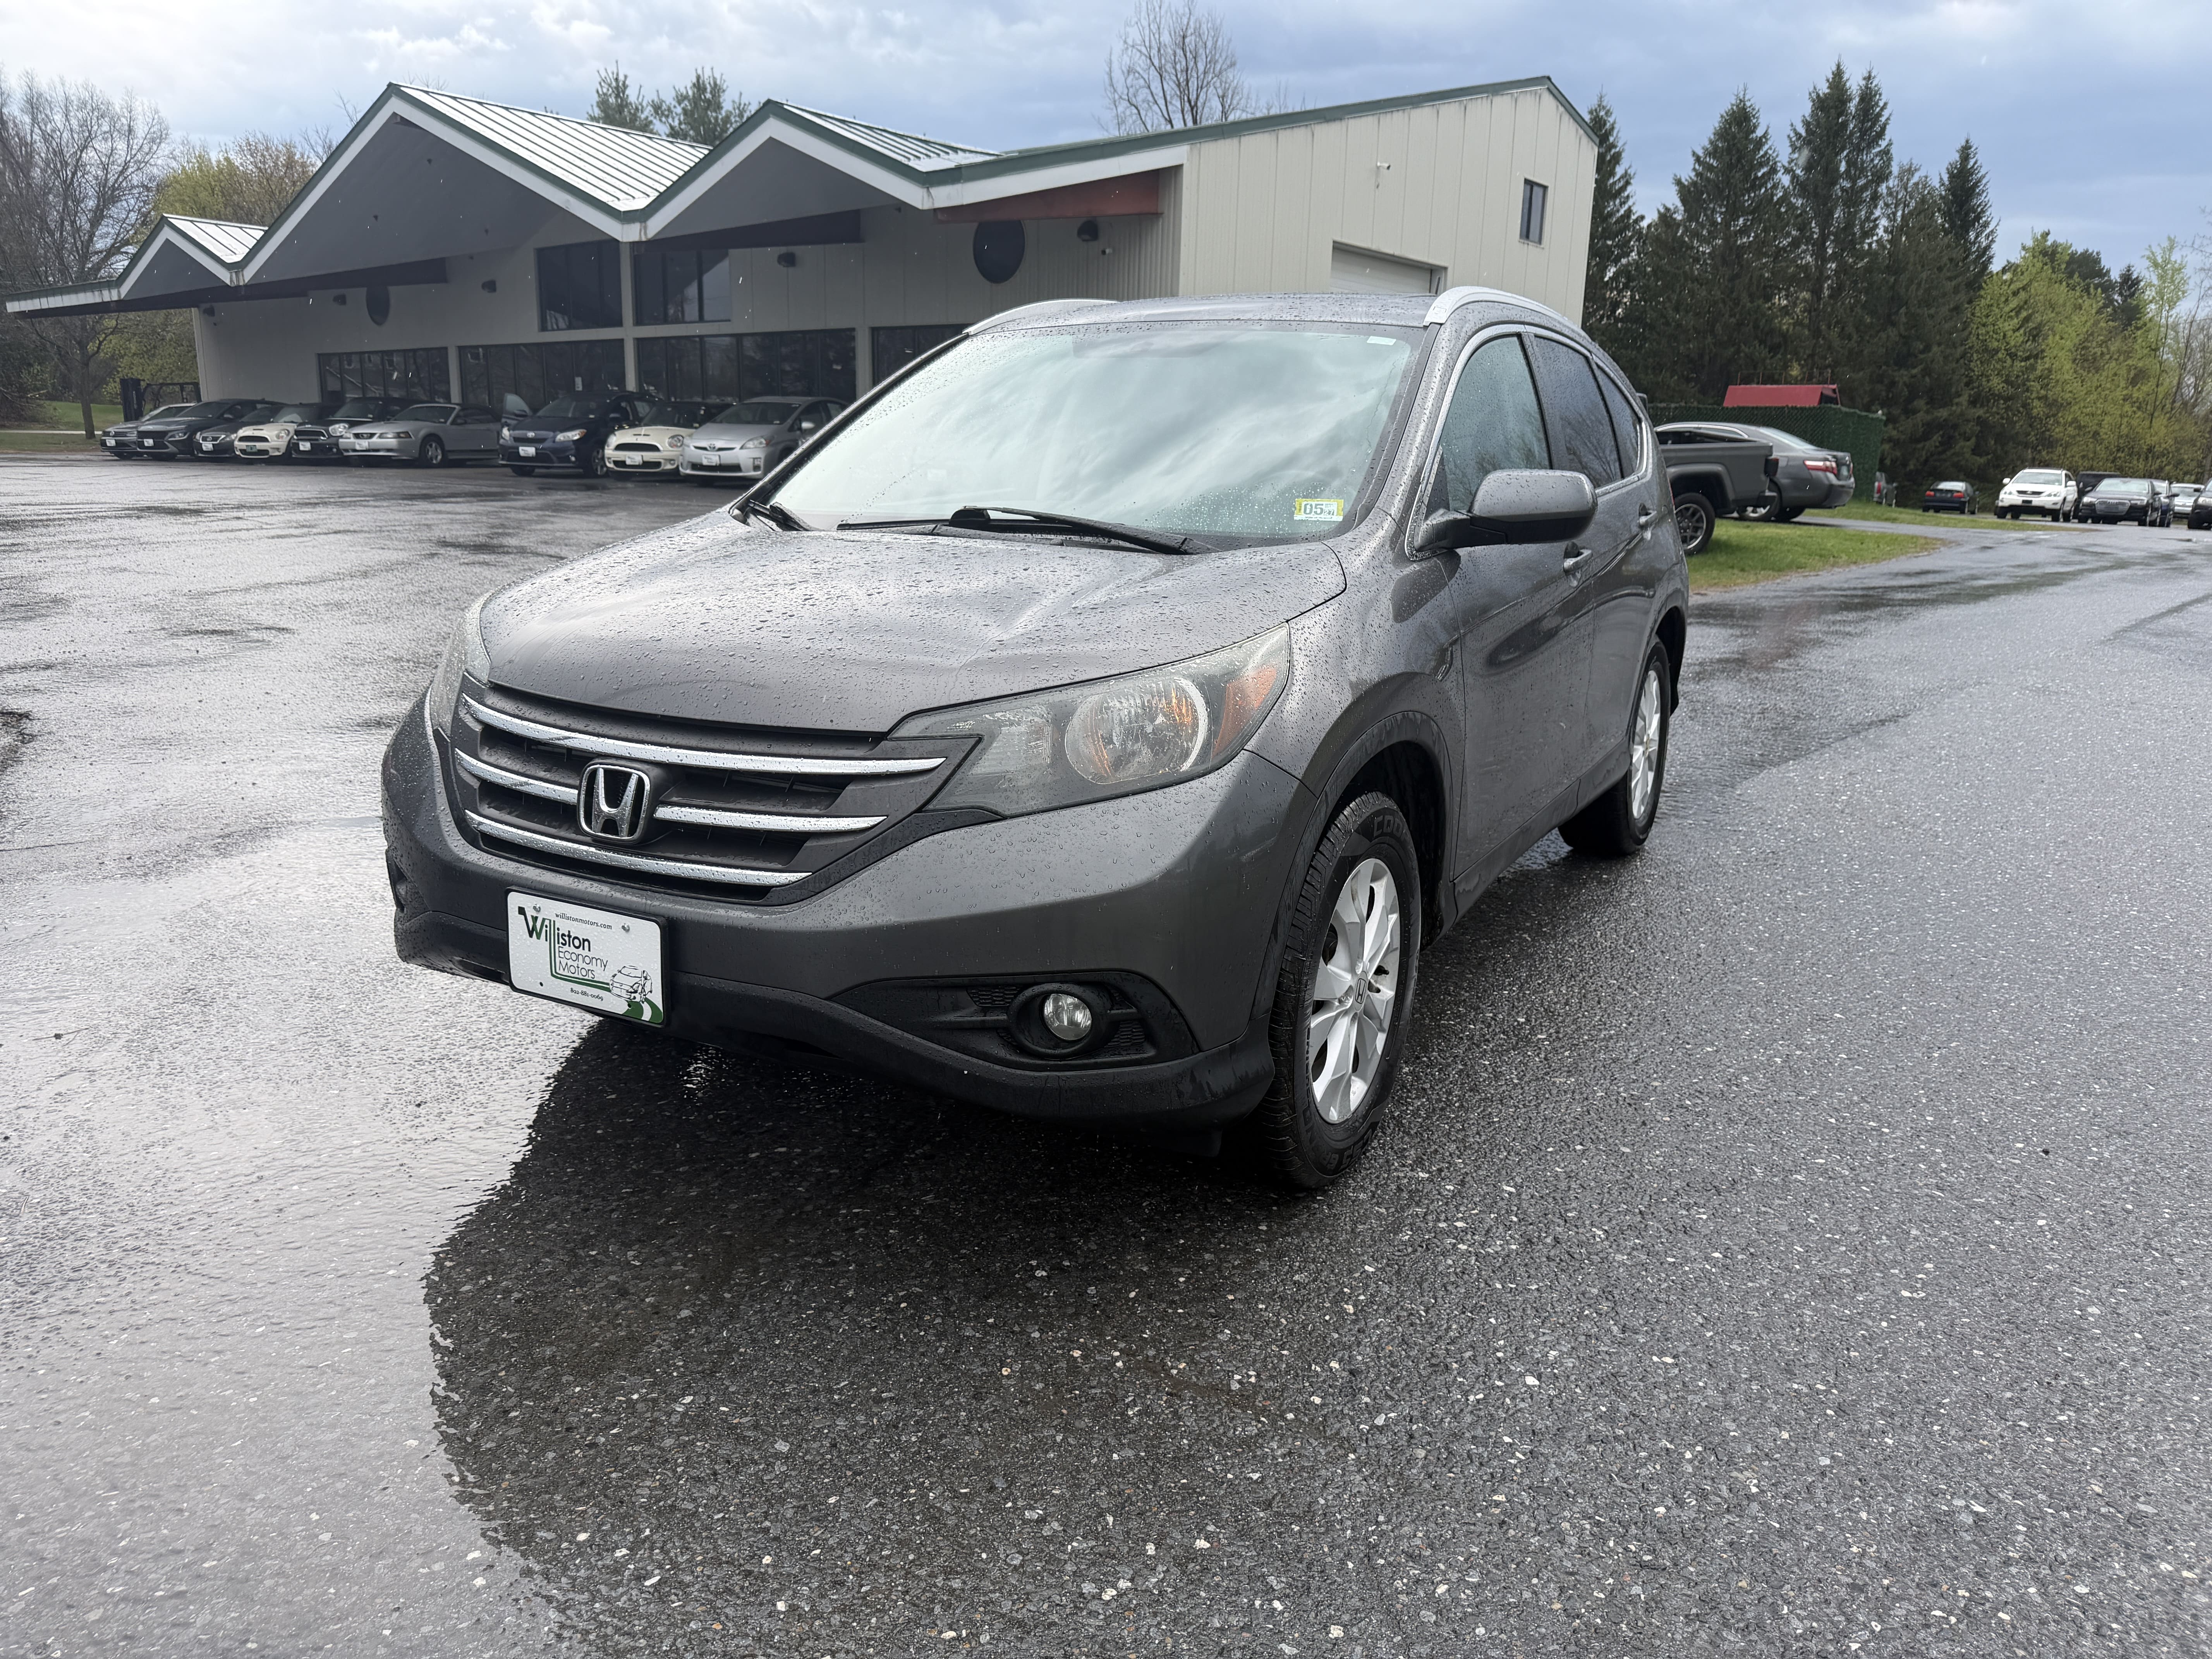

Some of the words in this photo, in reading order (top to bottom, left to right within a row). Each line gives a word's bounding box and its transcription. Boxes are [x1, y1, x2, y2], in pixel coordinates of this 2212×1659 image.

[1303, 503, 1324, 515] 05
[518, 906, 591, 952] Williston
[555, 912, 612, 929] willistonmotors.com
[558, 946, 608, 972] Economy
[559, 959, 595, 979] Motors
[570, 988, 603, 1001] 802-881-0069
